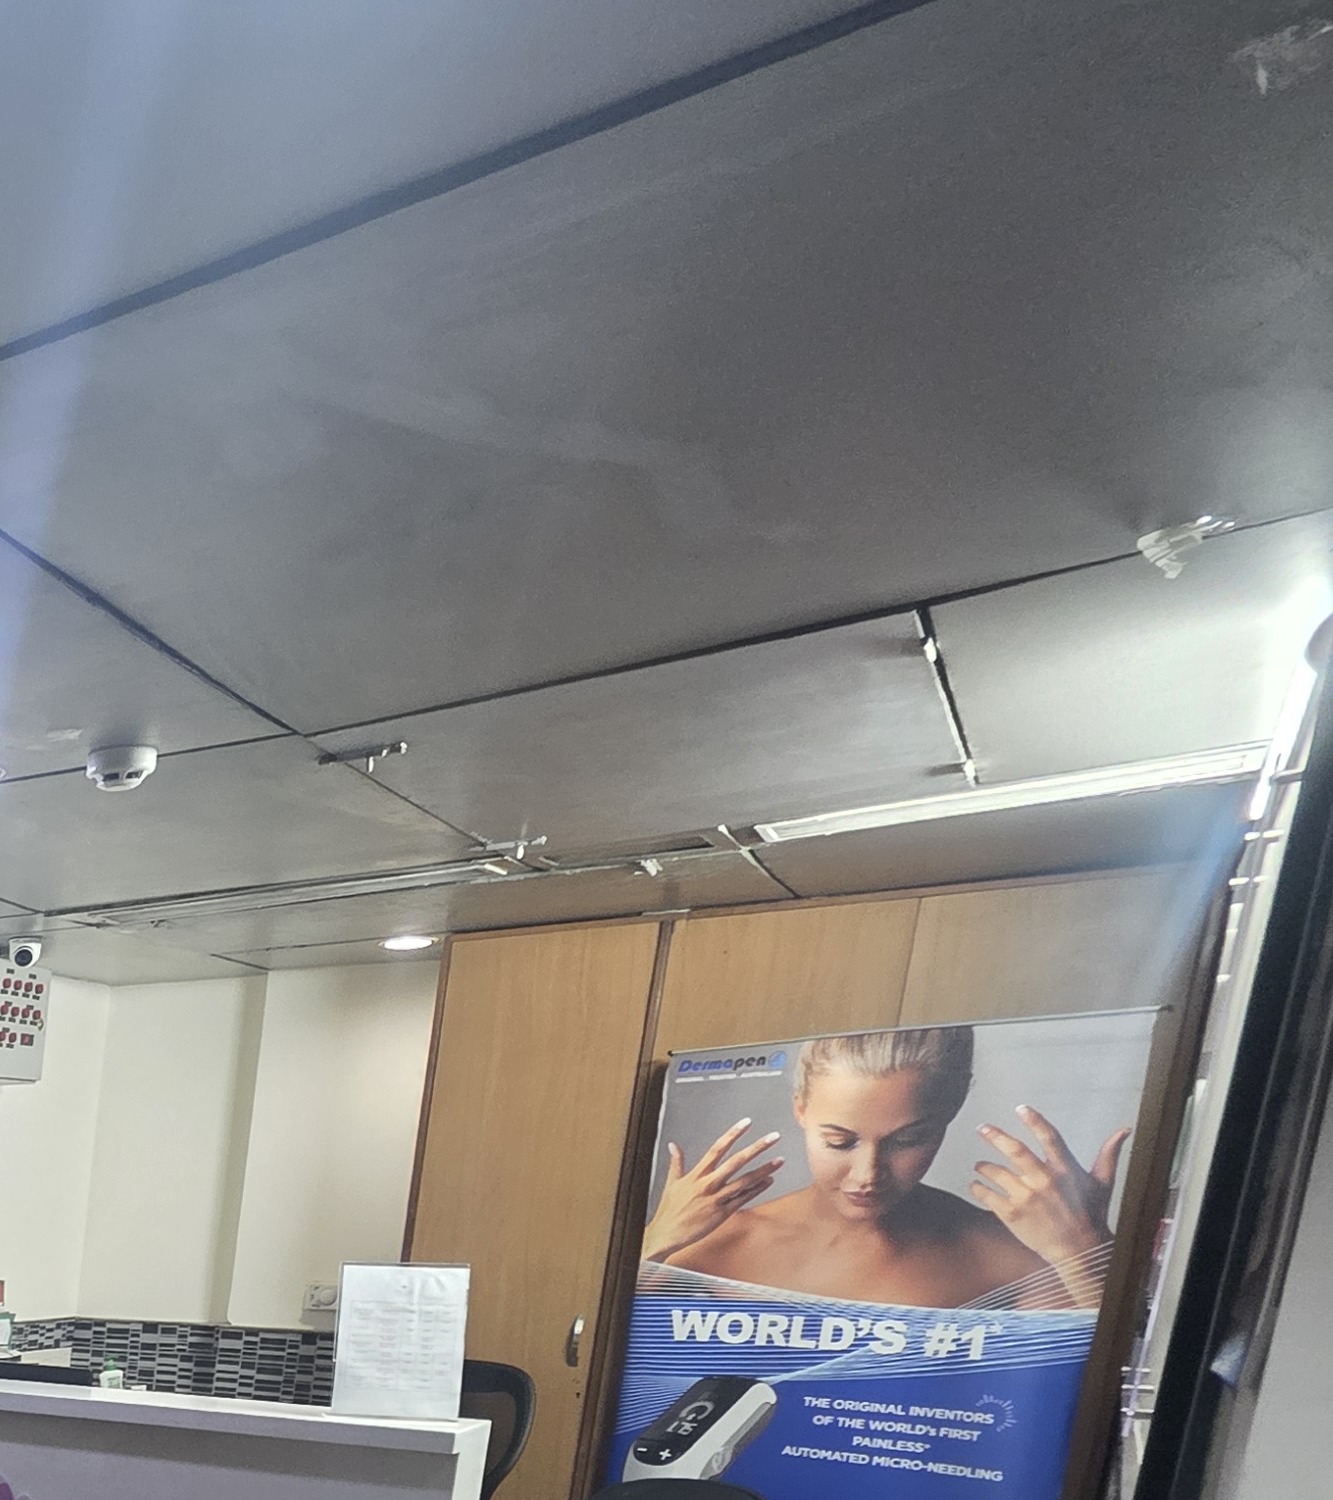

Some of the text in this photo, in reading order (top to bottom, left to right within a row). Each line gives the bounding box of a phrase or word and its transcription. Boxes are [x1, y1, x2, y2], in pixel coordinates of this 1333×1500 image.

[678, 1056, 767, 1072] Dermapen
[670, 1309, 908, 1355] WORLD'S
[803, 1396, 995, 1425] THE ORIGINAL INVENTORS
[812, 1415, 835, 1426] OF
[837, 1417, 865, 1430] THE
[939, 1427, 982, 1442] FIRST
[781, 1445, 1004, 1482] AUTOMATED MICRO-NEEDLING
